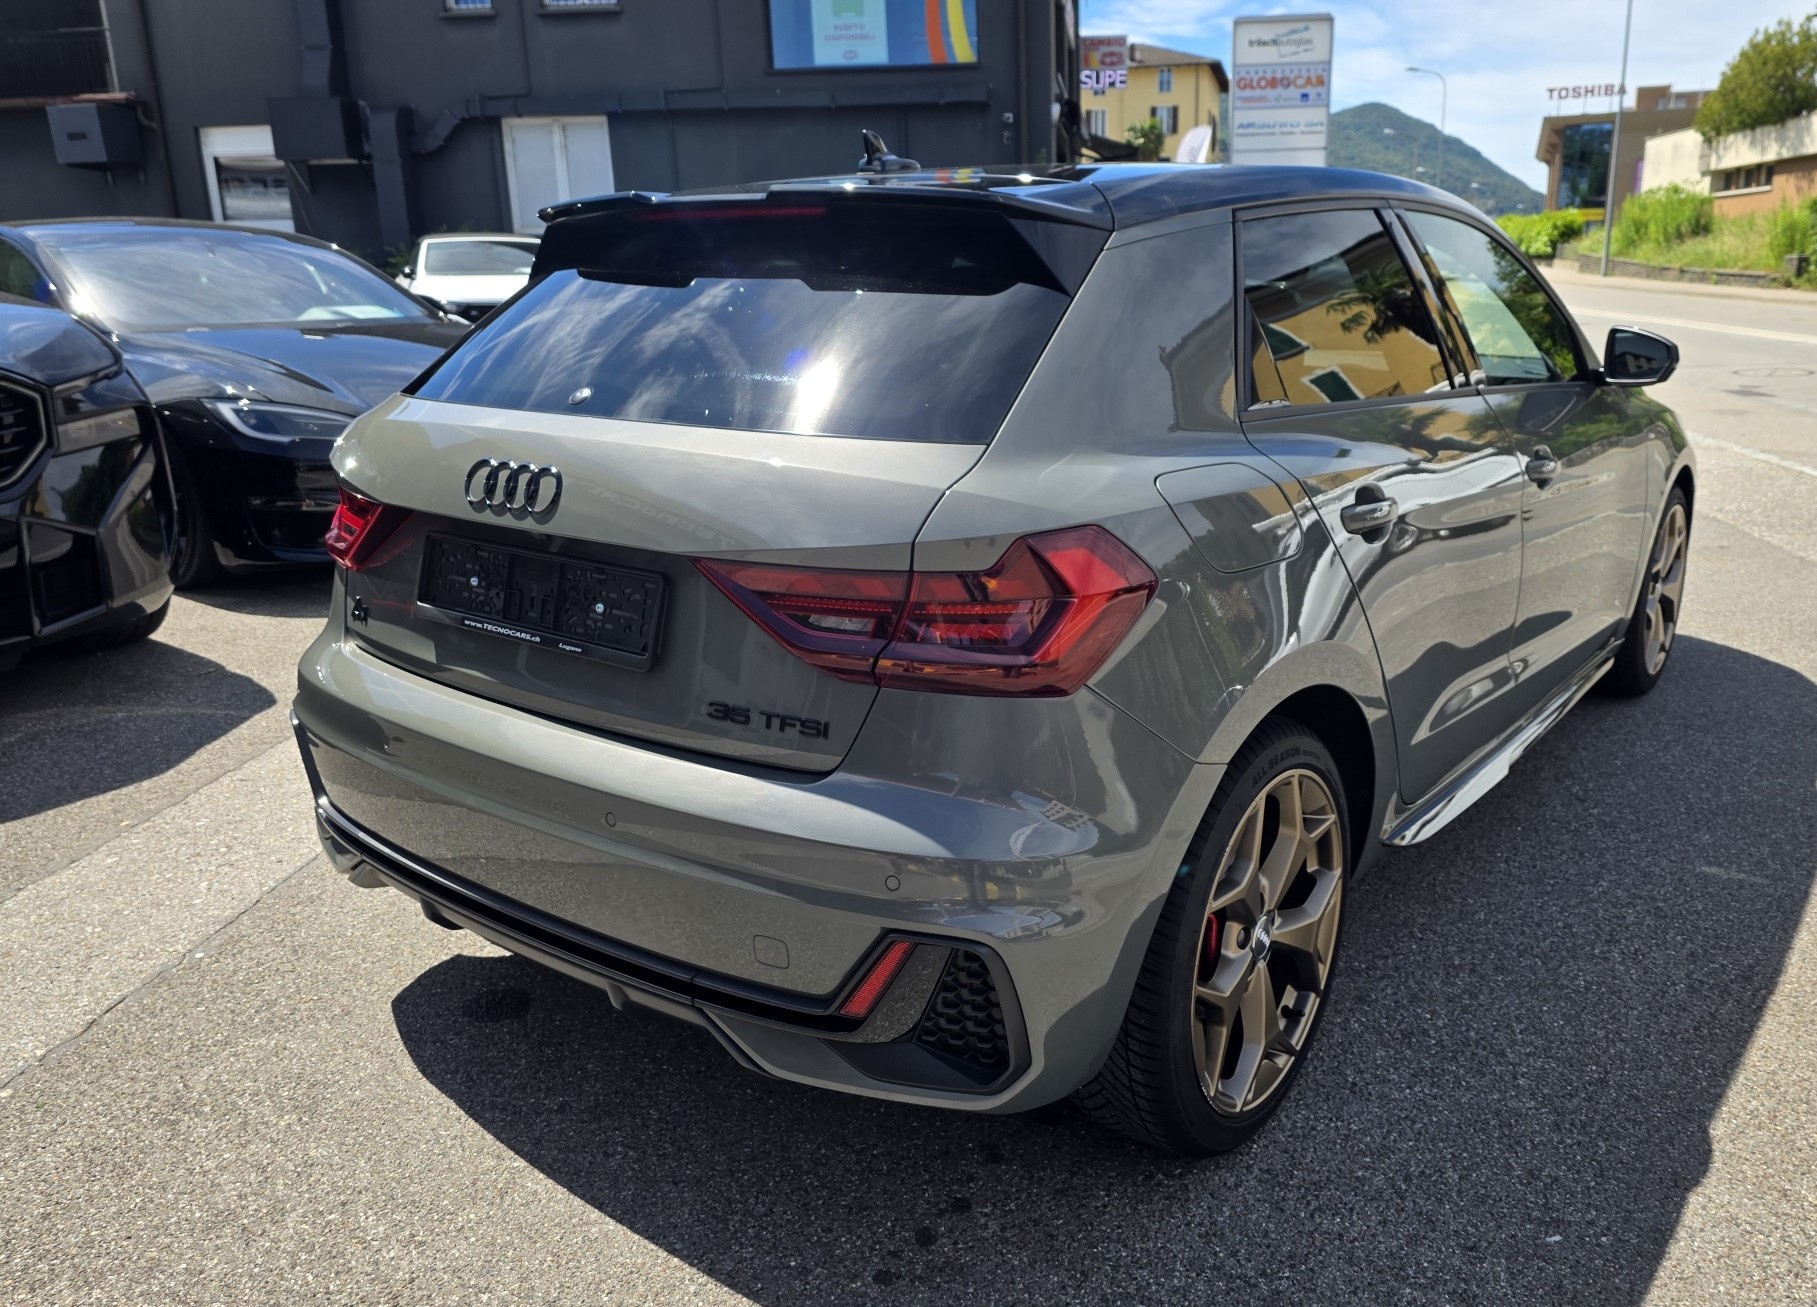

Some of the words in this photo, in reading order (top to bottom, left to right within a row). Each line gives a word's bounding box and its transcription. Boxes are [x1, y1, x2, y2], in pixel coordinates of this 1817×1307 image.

[1547, 83, 1626, 100] TOSHIBA
[464, 619, 541, 643] www.TECNOCARS.ch
[559, 642, 582, 653] Lugano
[706, 701, 751, 726] 35
[759, 710, 830, 740] TFSI
[1252, 766, 1268, 788] ALL
[1268, 746, 1301, 770] SEASON
